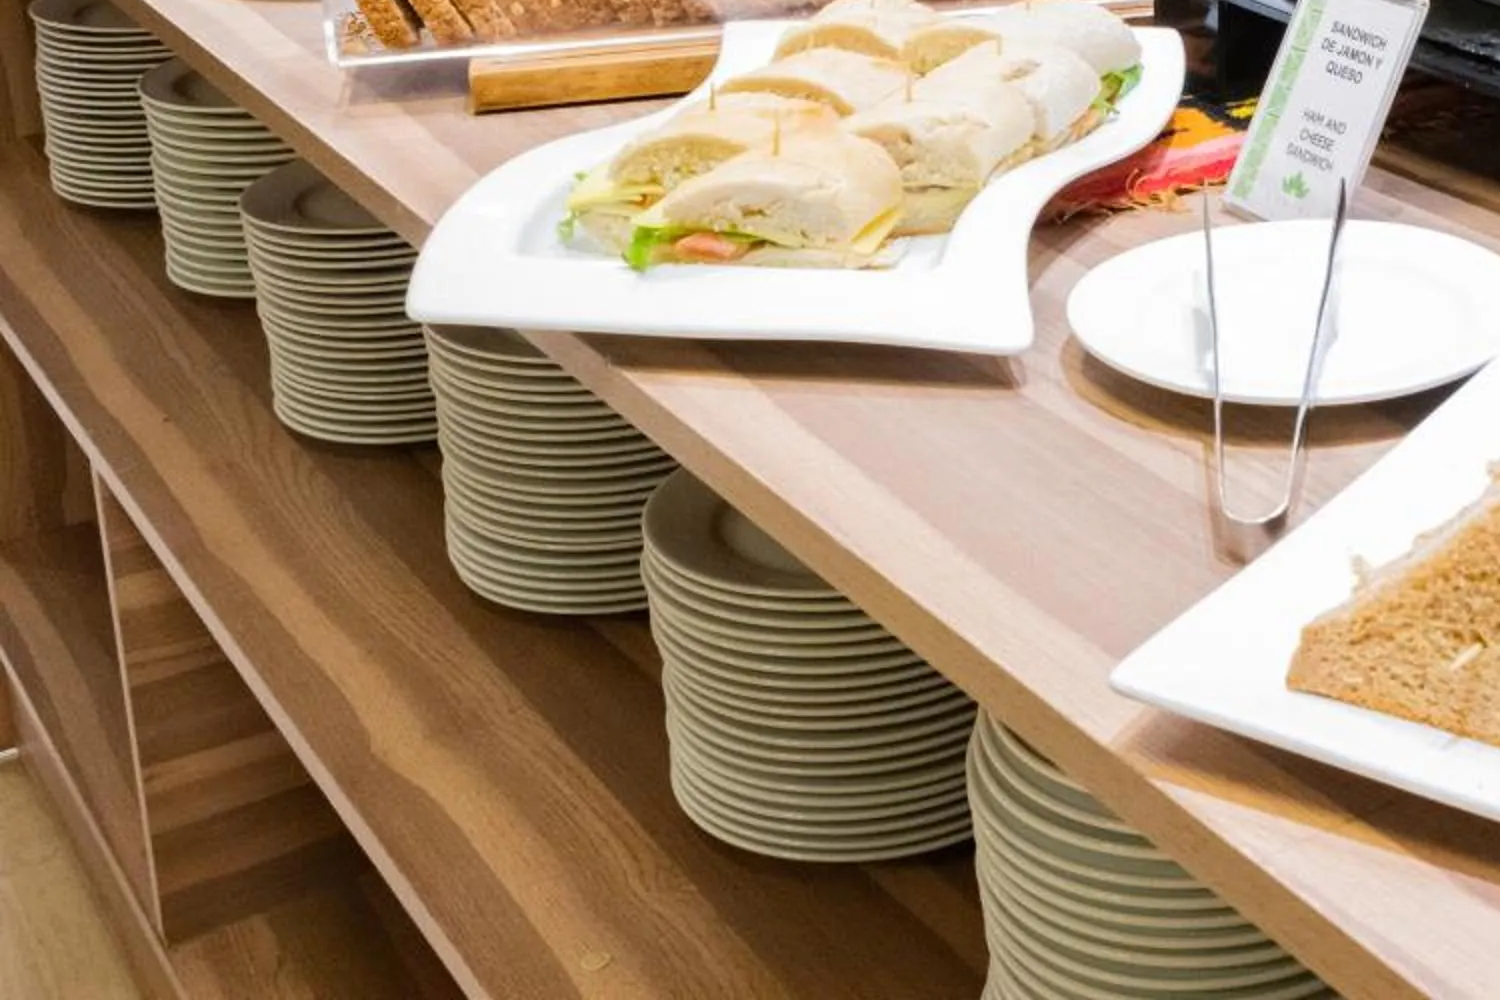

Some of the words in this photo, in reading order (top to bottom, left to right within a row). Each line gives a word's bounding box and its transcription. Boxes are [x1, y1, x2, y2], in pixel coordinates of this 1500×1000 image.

[1331, 20, 1387, 49] SANDWICH
[1321, 37, 1336, 54] DE
[1375, 56, 1384, 71] Y
[1325, 60, 1363, 85] QUESO
[1303, 110, 1325, 126] HAM
[1325, 118, 1347, 135] AND
[1299, 128, 1336, 151] CHEESE
[1286, 143, 1334, 171] SANDWICH
